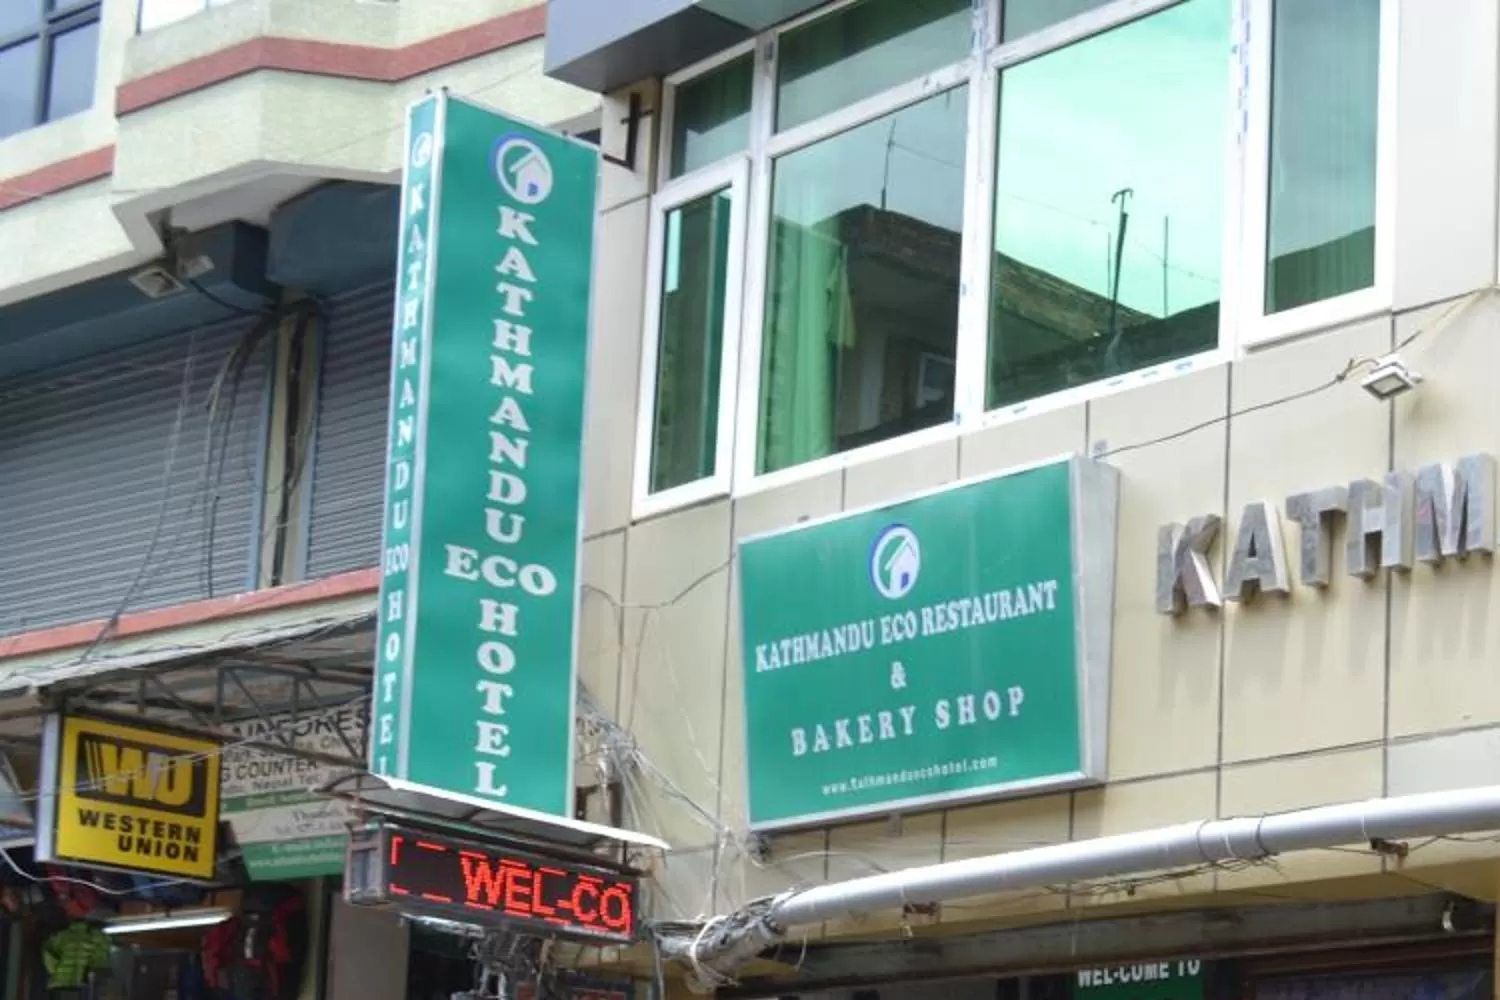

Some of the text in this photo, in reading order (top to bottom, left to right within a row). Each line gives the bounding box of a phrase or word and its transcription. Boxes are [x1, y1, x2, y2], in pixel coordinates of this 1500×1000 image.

[392, 182, 426, 530] KATHMANDU
[443, 204, 557, 797] KATHMANDU ECO HOTEL
[755, 579, 1058, 673] KATHMANDU ECO RESTAURANT
[890, 661, 907, 689] &
[790, 686, 1025, 756] BAKERY SHOP
[78, 807, 201, 843] WESTERN
[118, 833, 199, 862] UNION
